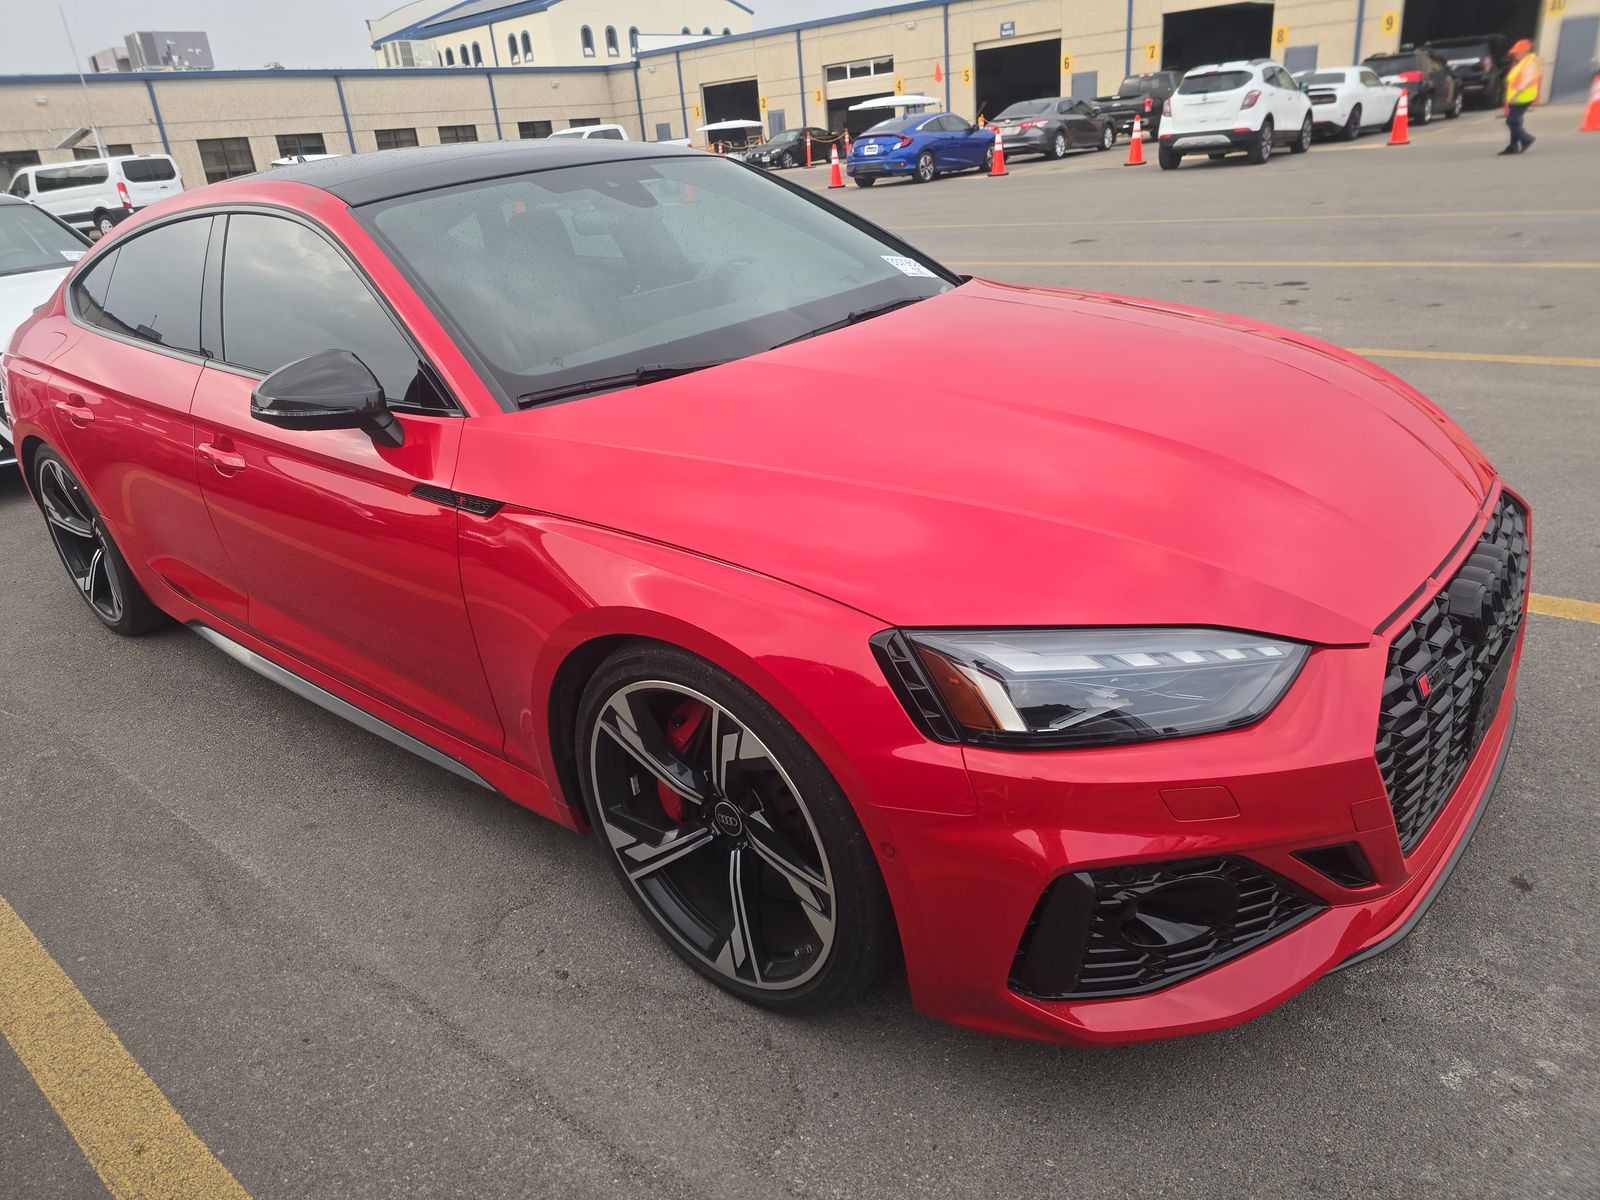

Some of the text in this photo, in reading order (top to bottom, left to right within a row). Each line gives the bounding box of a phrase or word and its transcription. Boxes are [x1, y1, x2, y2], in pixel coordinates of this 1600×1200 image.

[1386, 16, 1393, 31] 9
[1277, 29, 1284, 43] 8
[1149, 45, 1155, 59] 7
[1064, 57, 1070, 69] 6
[964, 70, 970, 82] 5
